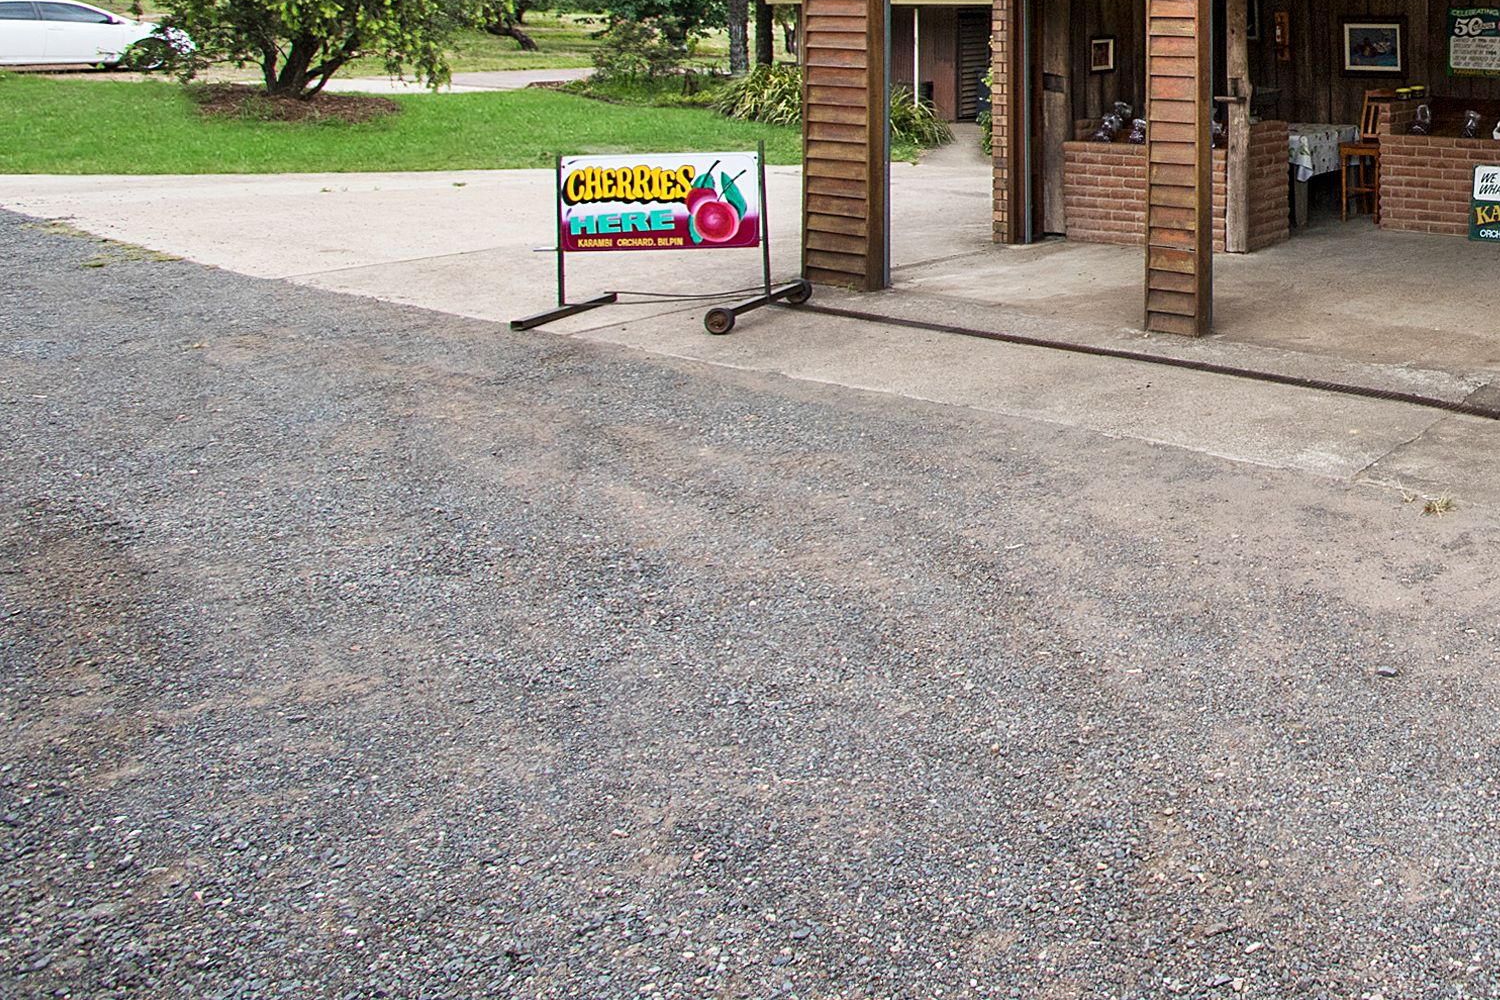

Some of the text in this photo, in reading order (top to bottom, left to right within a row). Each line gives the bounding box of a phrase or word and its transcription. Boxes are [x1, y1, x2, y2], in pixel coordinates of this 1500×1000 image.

[565, 164, 695, 202] CHERRIES
[1480, 172, 1498, 183] WE
[570, 209, 675, 235] HERE
[577, 238, 613, 248] KARAMBI
[657, 237, 684, 247] BILPIN
